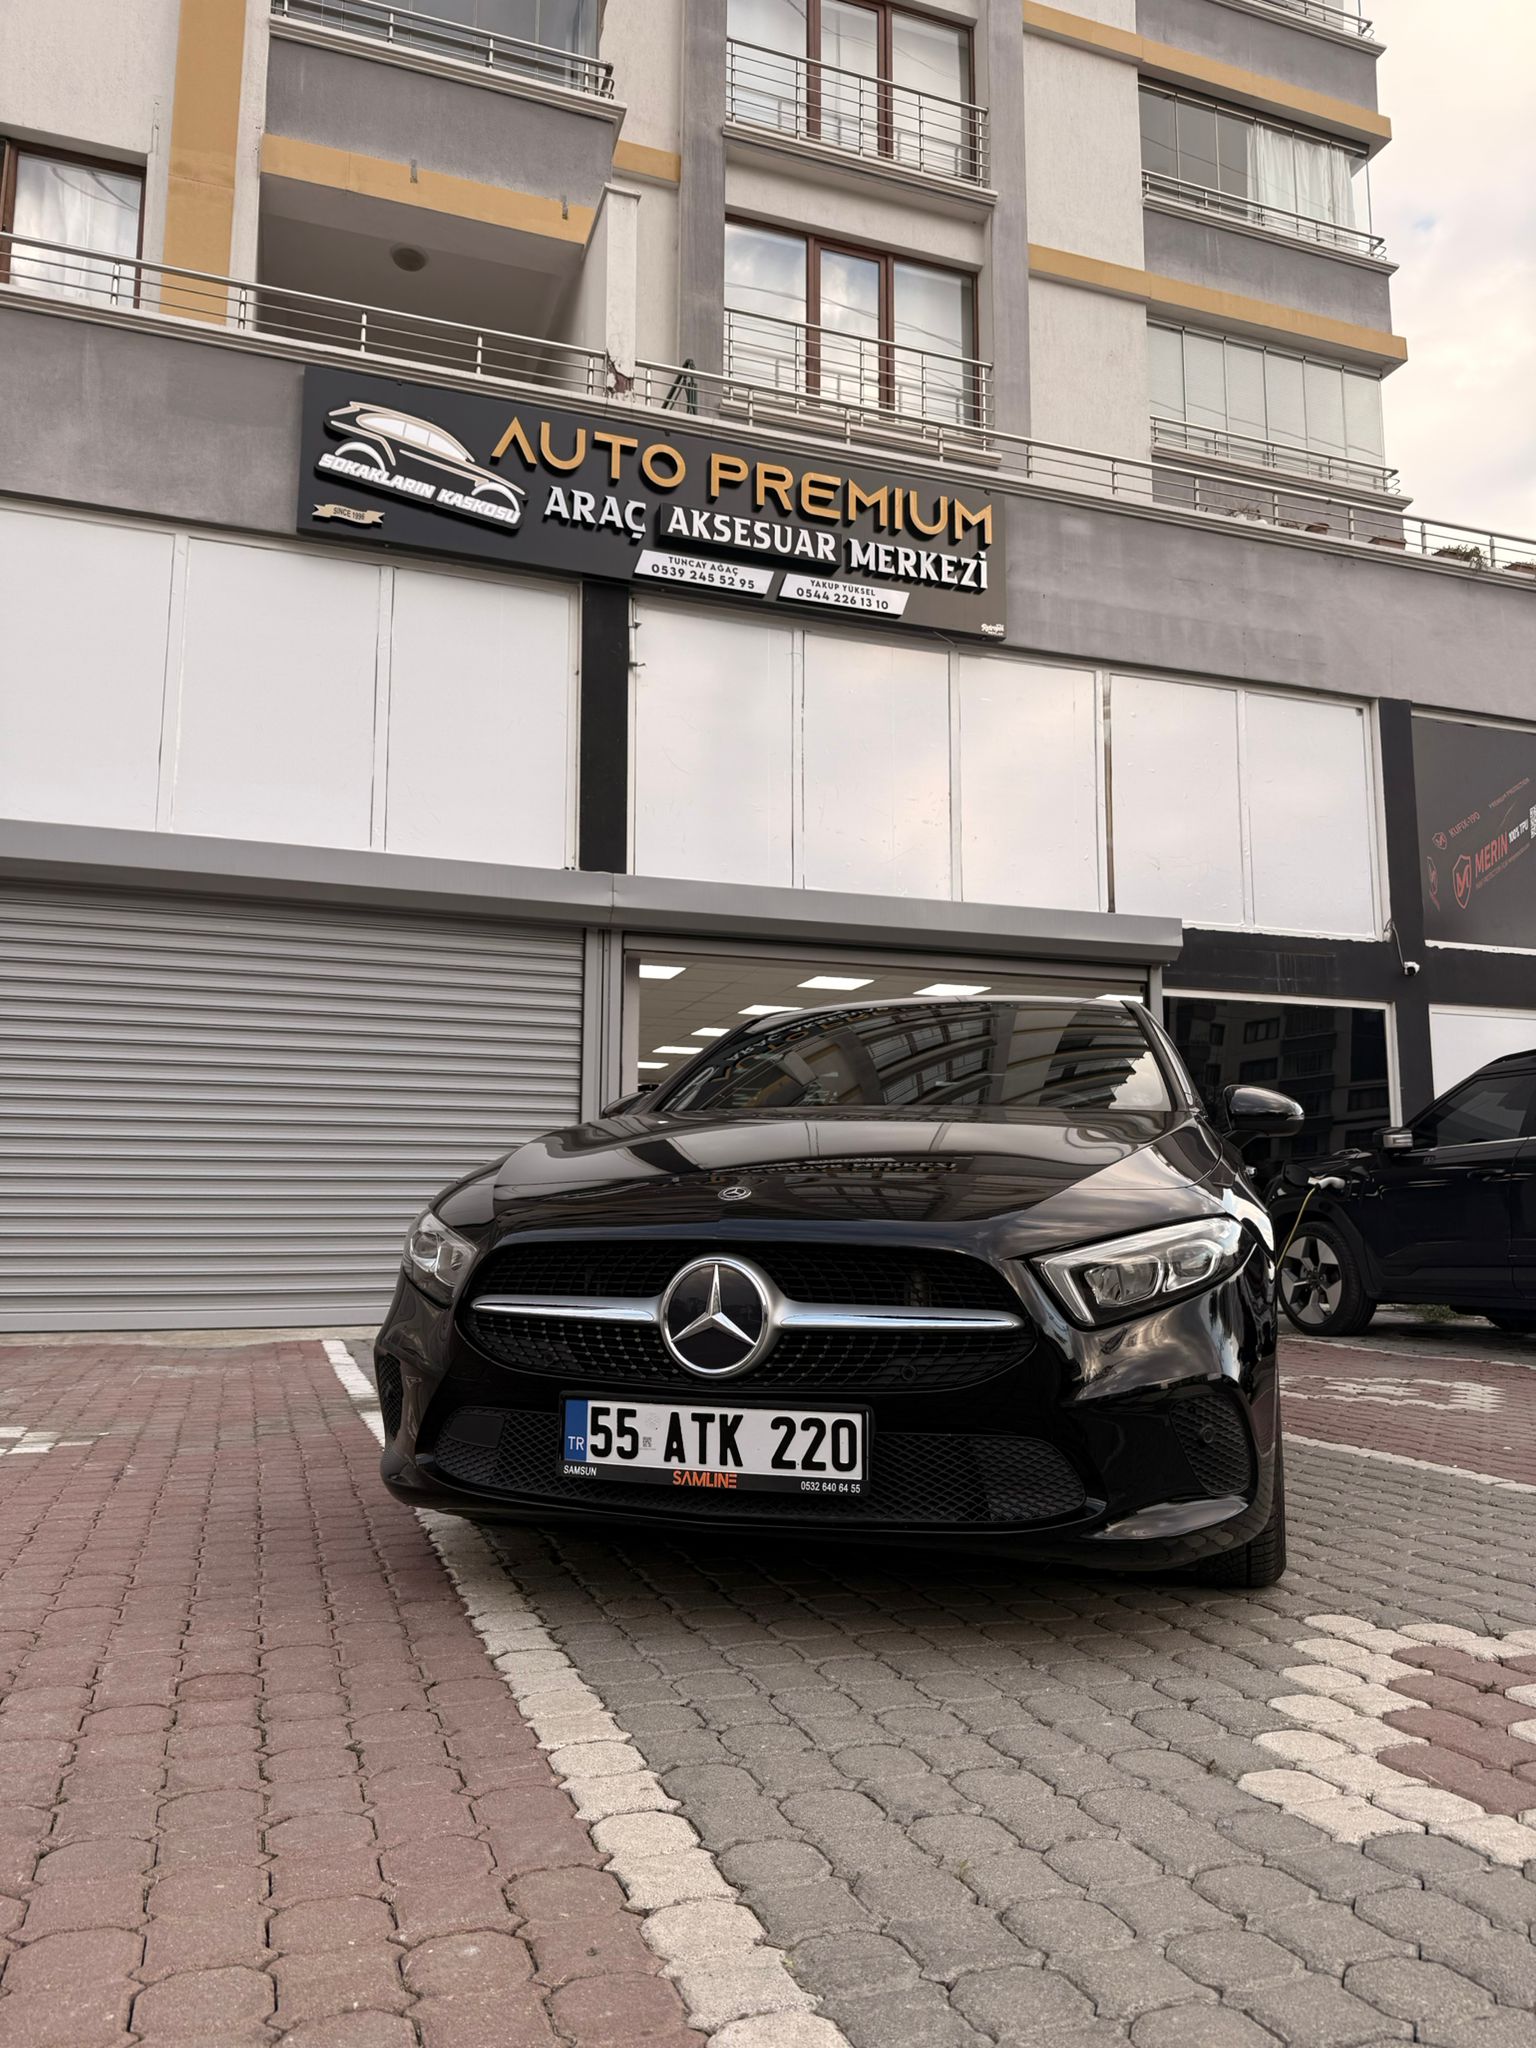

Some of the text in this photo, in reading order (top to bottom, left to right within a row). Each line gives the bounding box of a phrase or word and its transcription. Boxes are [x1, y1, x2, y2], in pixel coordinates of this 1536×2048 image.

[318, 453, 521, 524] SOKAKLARIN KASKOSU
[490, 416, 992, 545] AUTO PREMIUM
[333, 507, 351, 517] SINCE
[545, 486, 988, 590] ARAÇ AKSESUAR MERKEZİ
[651, 563, 755, 589] 0539 245 52 95
[668, 556, 739, 576] TUNCAY AĞAÇ
[796, 587, 889, 610] 0544 226 13 10
[810, 580, 876, 596] YAKUP YÜKSEL
[1475, 830, 1508, 878] MERIN
[568, 1436, 585, 1451] TR
[590, 1406, 857, 1472] 55 ATK 220
[563, 1465, 597, 1476] SAMSUN
[672, 1470, 737, 1488] SAMLINE
[800, 1481, 861, 1493] 0532 640 64 55
